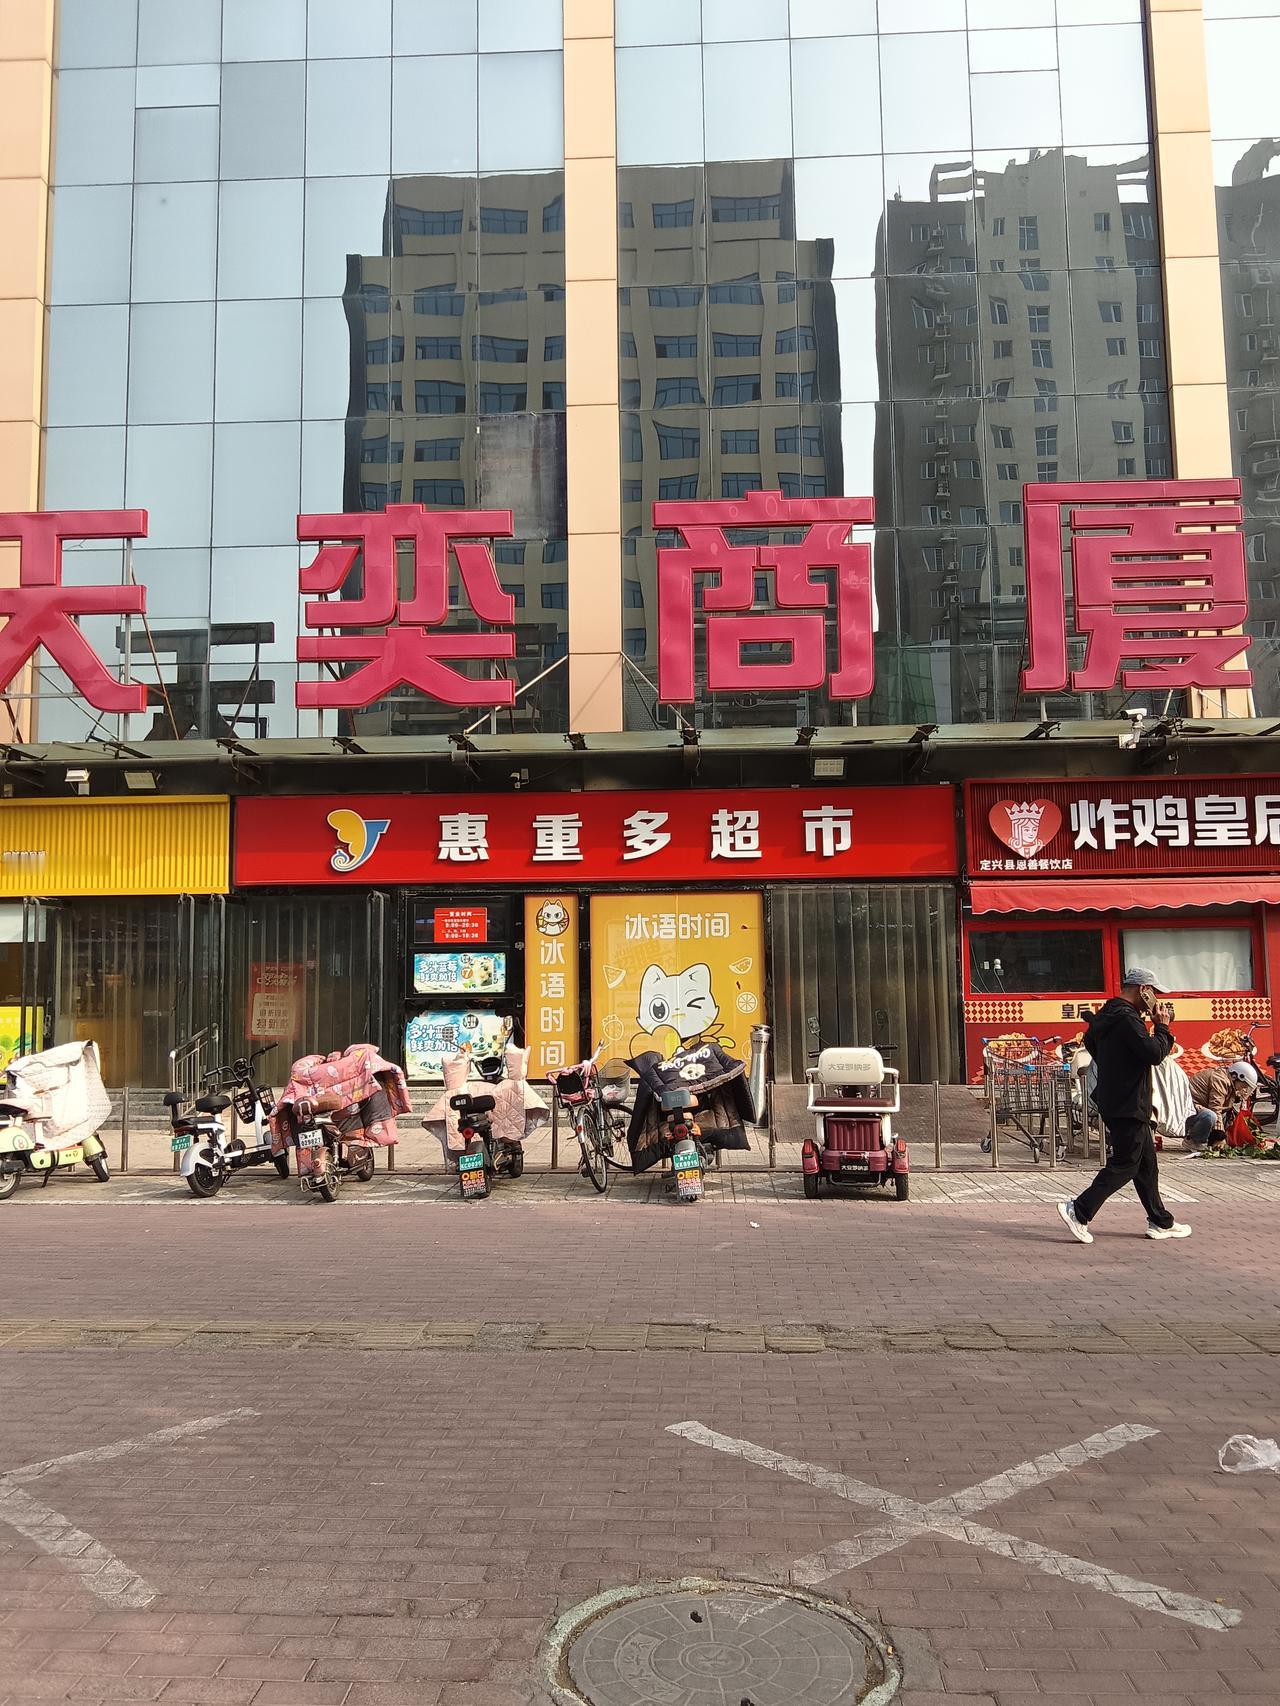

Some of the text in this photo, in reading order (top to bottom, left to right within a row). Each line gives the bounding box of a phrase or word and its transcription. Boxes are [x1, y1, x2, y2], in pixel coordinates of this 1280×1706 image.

[438, 806, 854, 862] 惠重多超市
[980, 859, 1072, 871] 定兴县恩善餐饮店
[625, 912, 731, 940] 冰语时间
[540, 938, 565, 1067] 冰语时间
